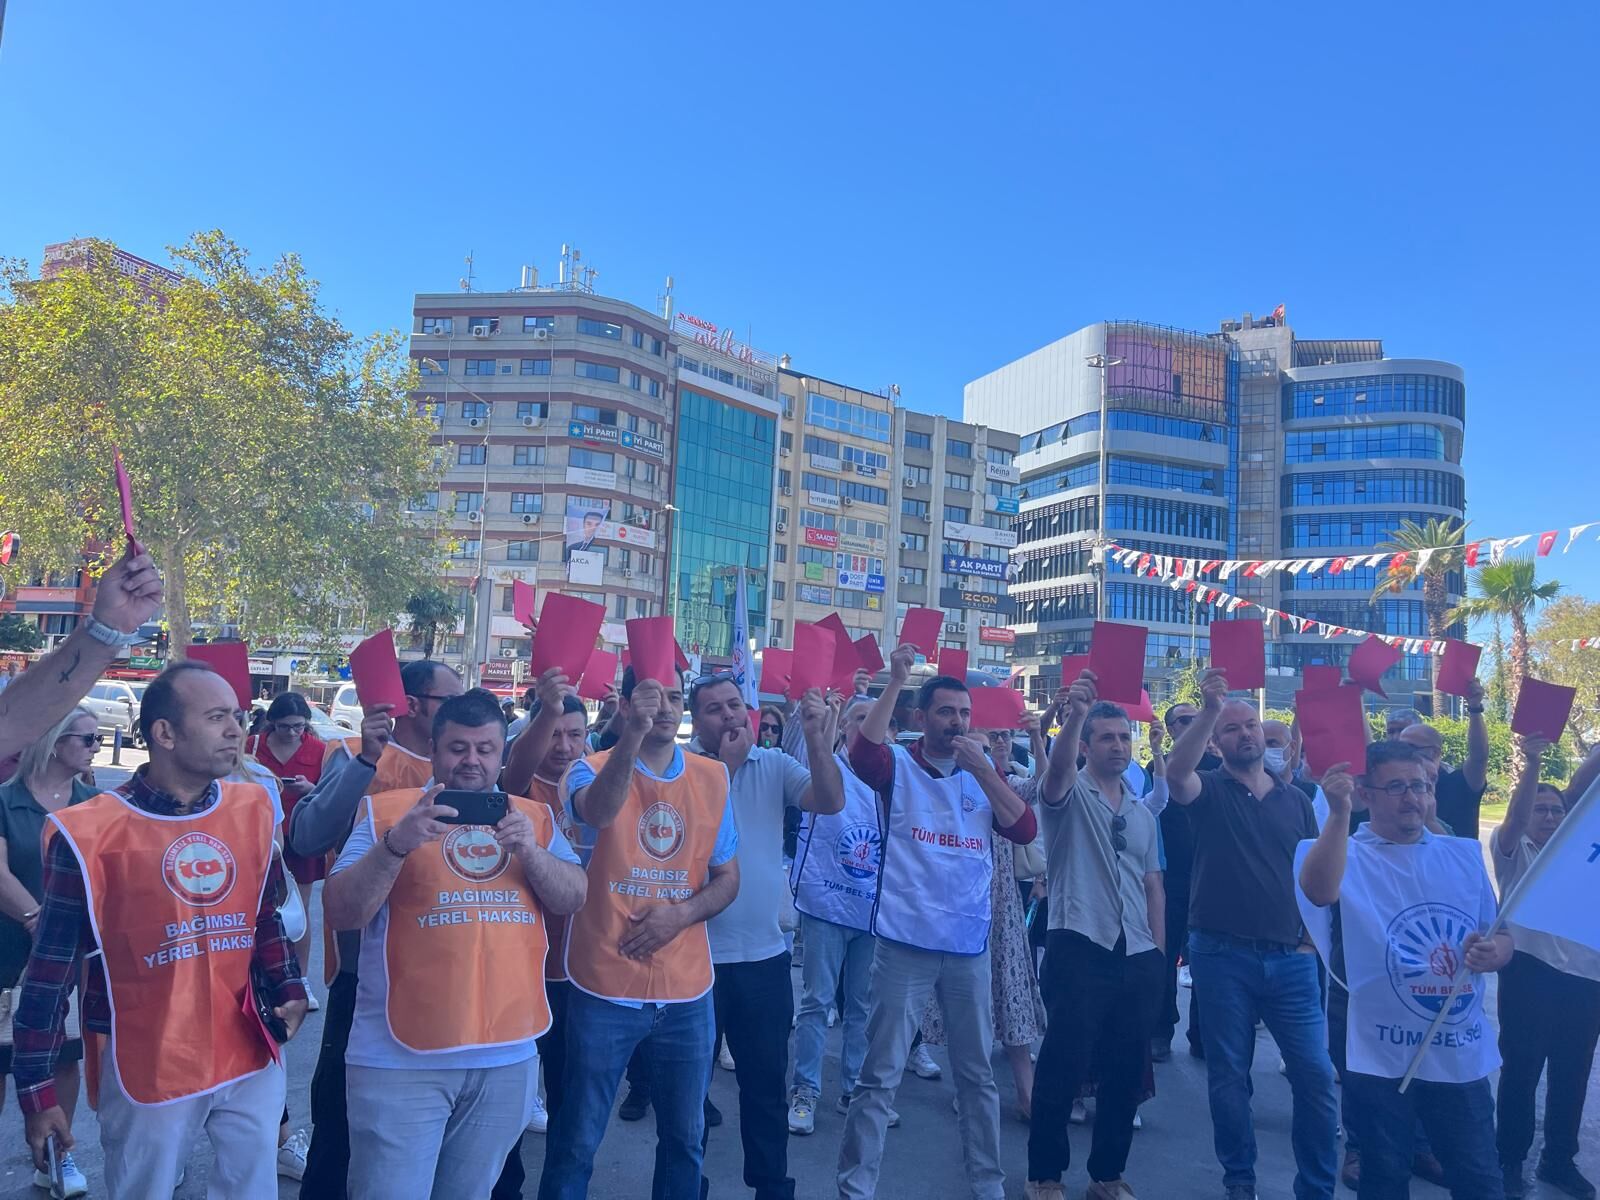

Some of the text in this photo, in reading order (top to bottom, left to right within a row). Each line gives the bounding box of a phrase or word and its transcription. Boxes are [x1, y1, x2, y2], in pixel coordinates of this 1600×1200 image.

[595, 427, 618, 438] PARTİ
[990, 465, 1010, 477] Reina
[960, 560, 1002, 573] AK PARTİ
[911, 826, 983, 850] TÜM BEL-SEN
[438, 887, 520, 905] BAĞIMSIZ
[608, 881, 652, 898] YEREL
[164, 912, 247, 938] BAĞIMSIZ
[416, 910, 536, 929] YEREL HAKSEN
[143, 942, 206, 969] YEREL
[1375, 1024, 1423, 1047] TÜM
